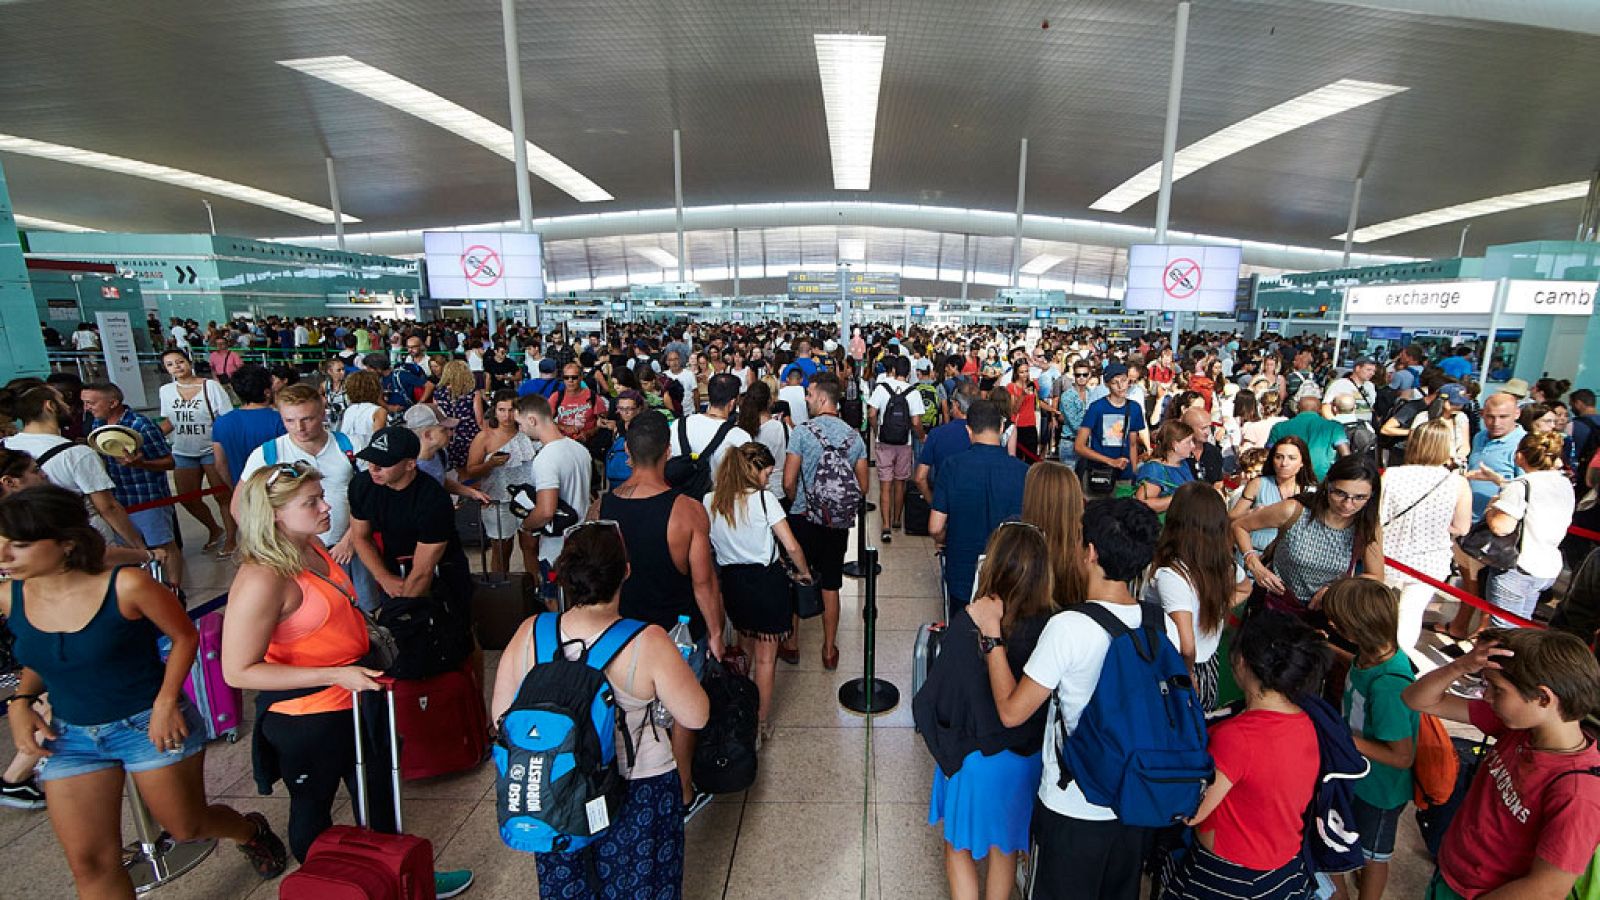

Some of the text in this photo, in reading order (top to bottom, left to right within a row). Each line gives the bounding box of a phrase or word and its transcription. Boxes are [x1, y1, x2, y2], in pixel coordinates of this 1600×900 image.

[1386, 289, 1460, 308] exchange
[1534, 289, 1590, 305] camb
[172, 398, 202, 409] SAVE
[174, 411, 195, 422] THE
[526, 757, 543, 812] NOROESTE
[508, 783, 521, 812] PASO
